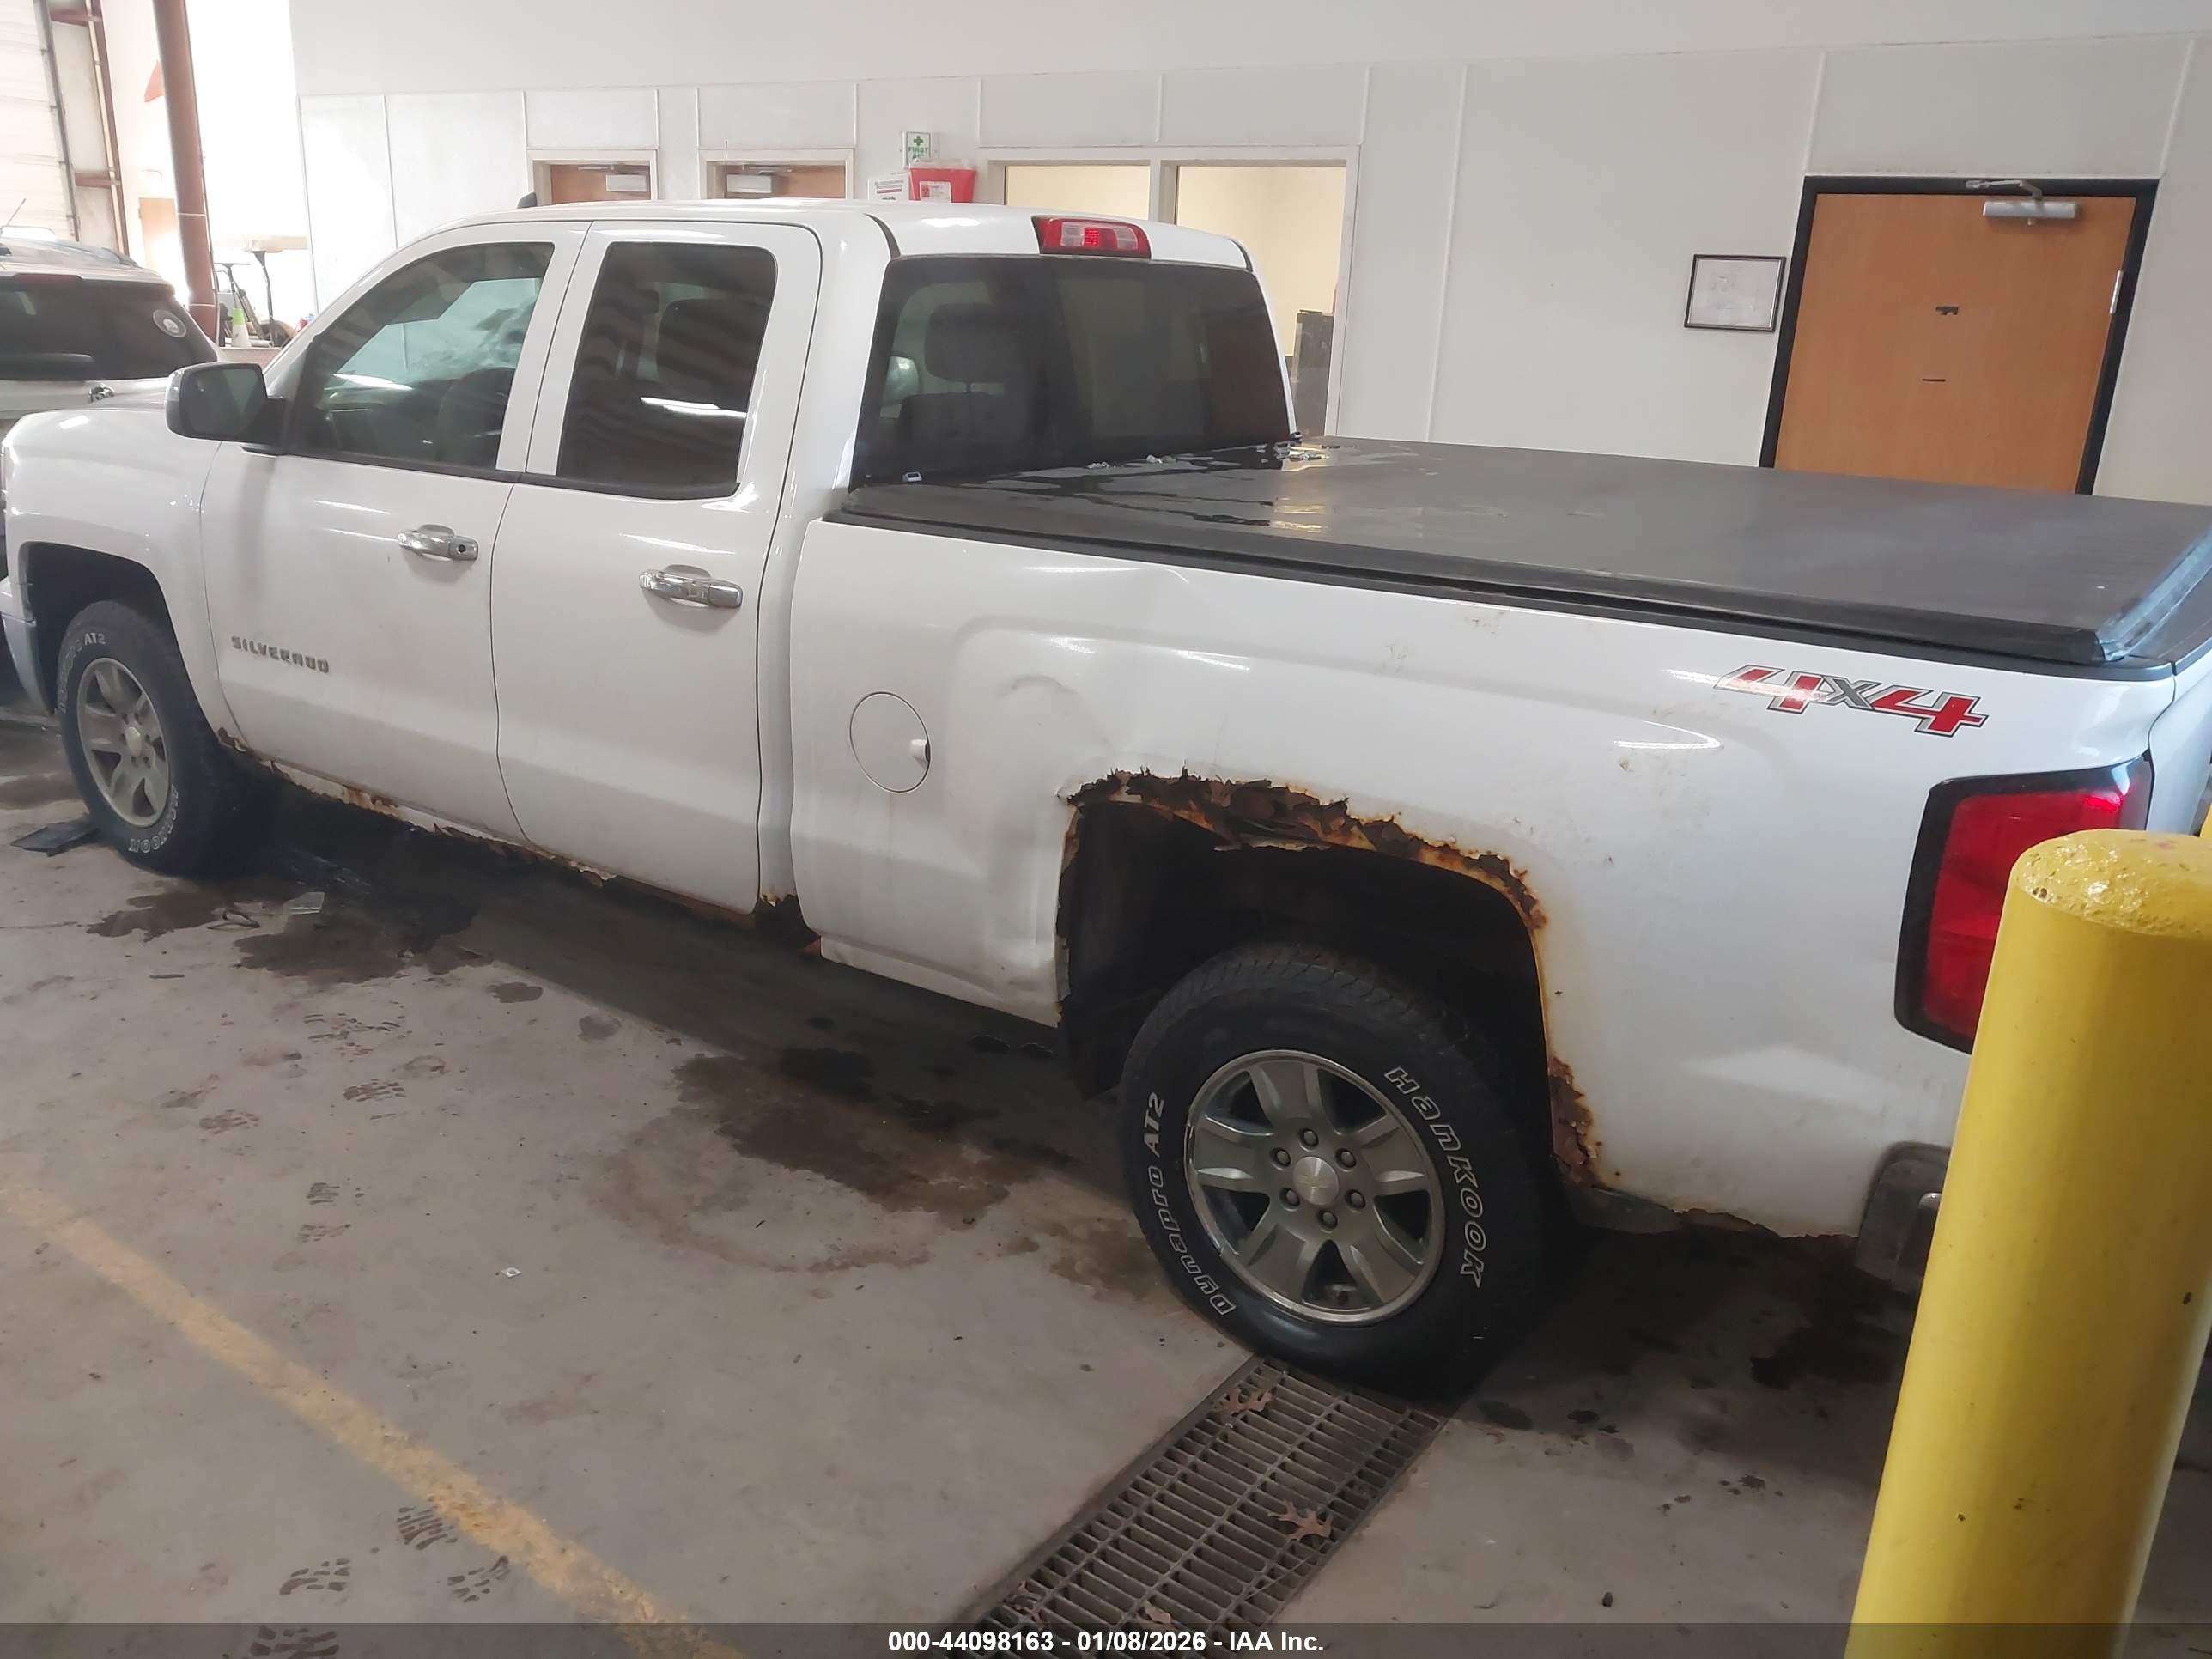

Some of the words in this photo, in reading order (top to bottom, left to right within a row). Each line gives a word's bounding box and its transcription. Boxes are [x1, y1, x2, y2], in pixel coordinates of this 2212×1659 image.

[84, 632, 106, 646] AT2
[231, 635, 330, 674] SILVERADO
[1143, 1091, 1165, 1158] AT2
